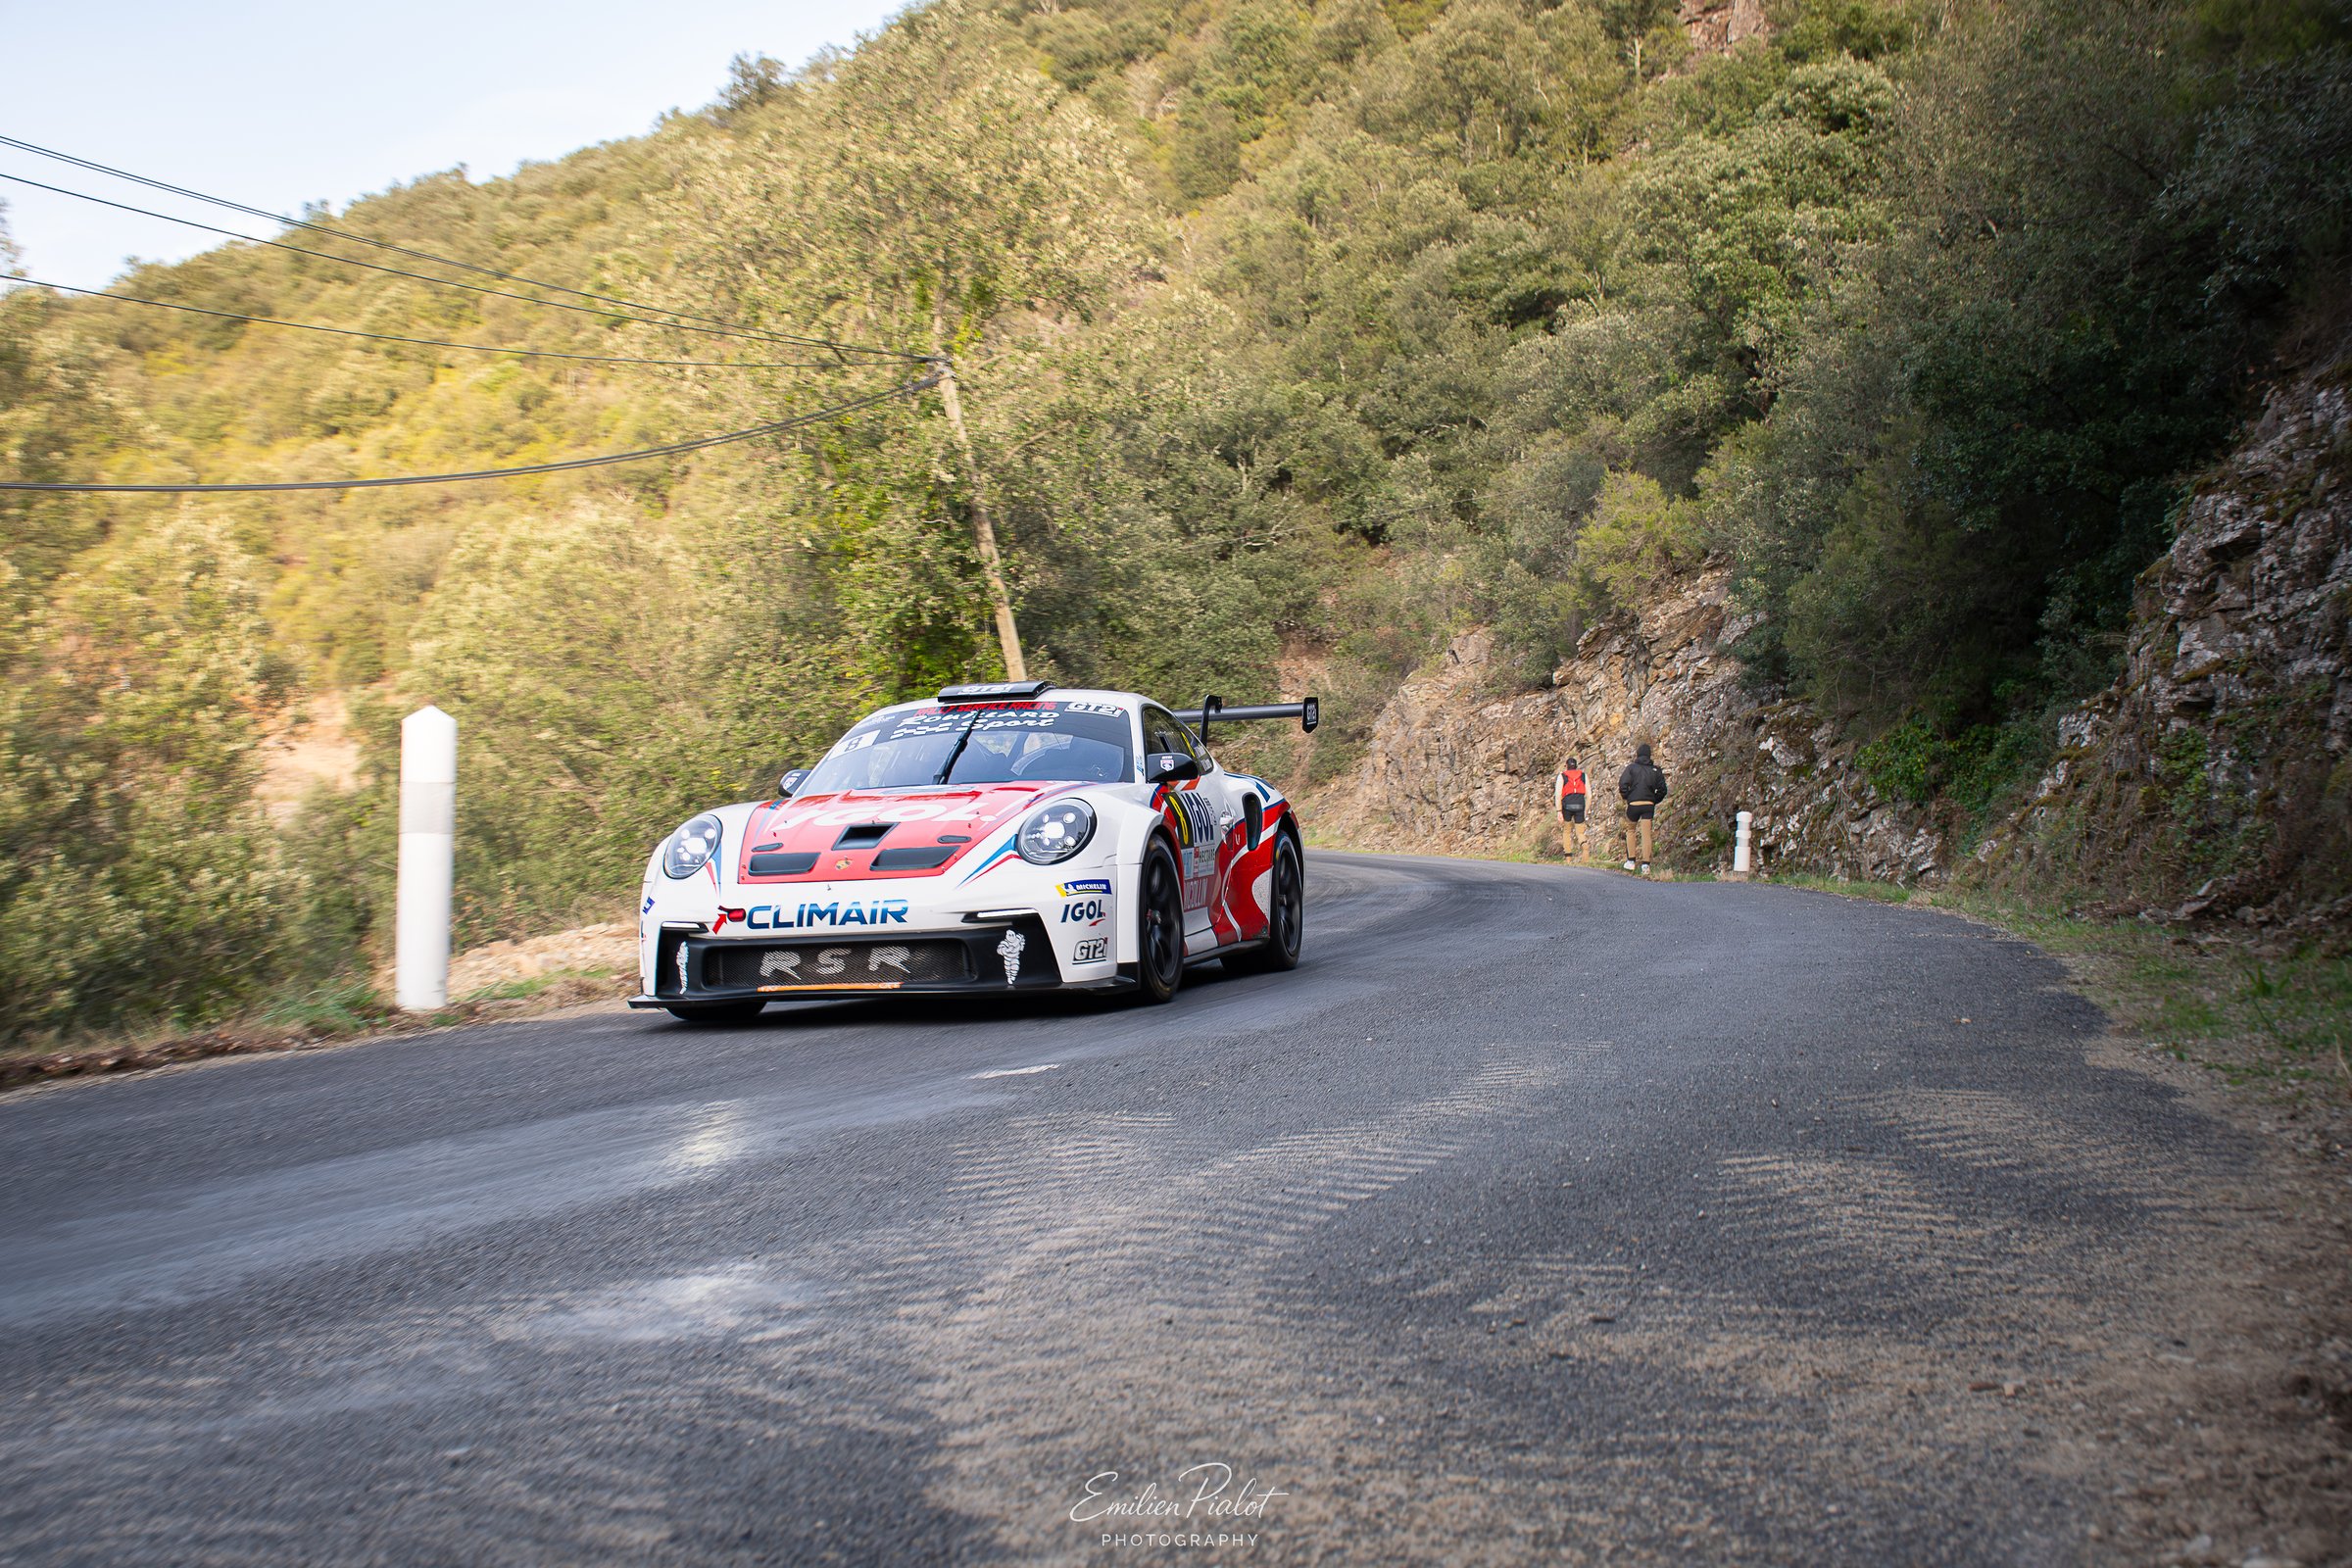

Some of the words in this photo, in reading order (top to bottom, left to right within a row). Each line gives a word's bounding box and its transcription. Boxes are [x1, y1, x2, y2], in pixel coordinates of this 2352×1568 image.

[914, 704, 955, 717] RALLY
[957, 702, 1007, 712] SERVICE
[1009, 701, 1058, 711] RACING
[1169, 795, 1189, 846] 8
[1181, 792, 1214, 844] IGOL
[747, 899, 909, 930] CLIMAIR
[1060, 899, 1103, 923] IGOL
